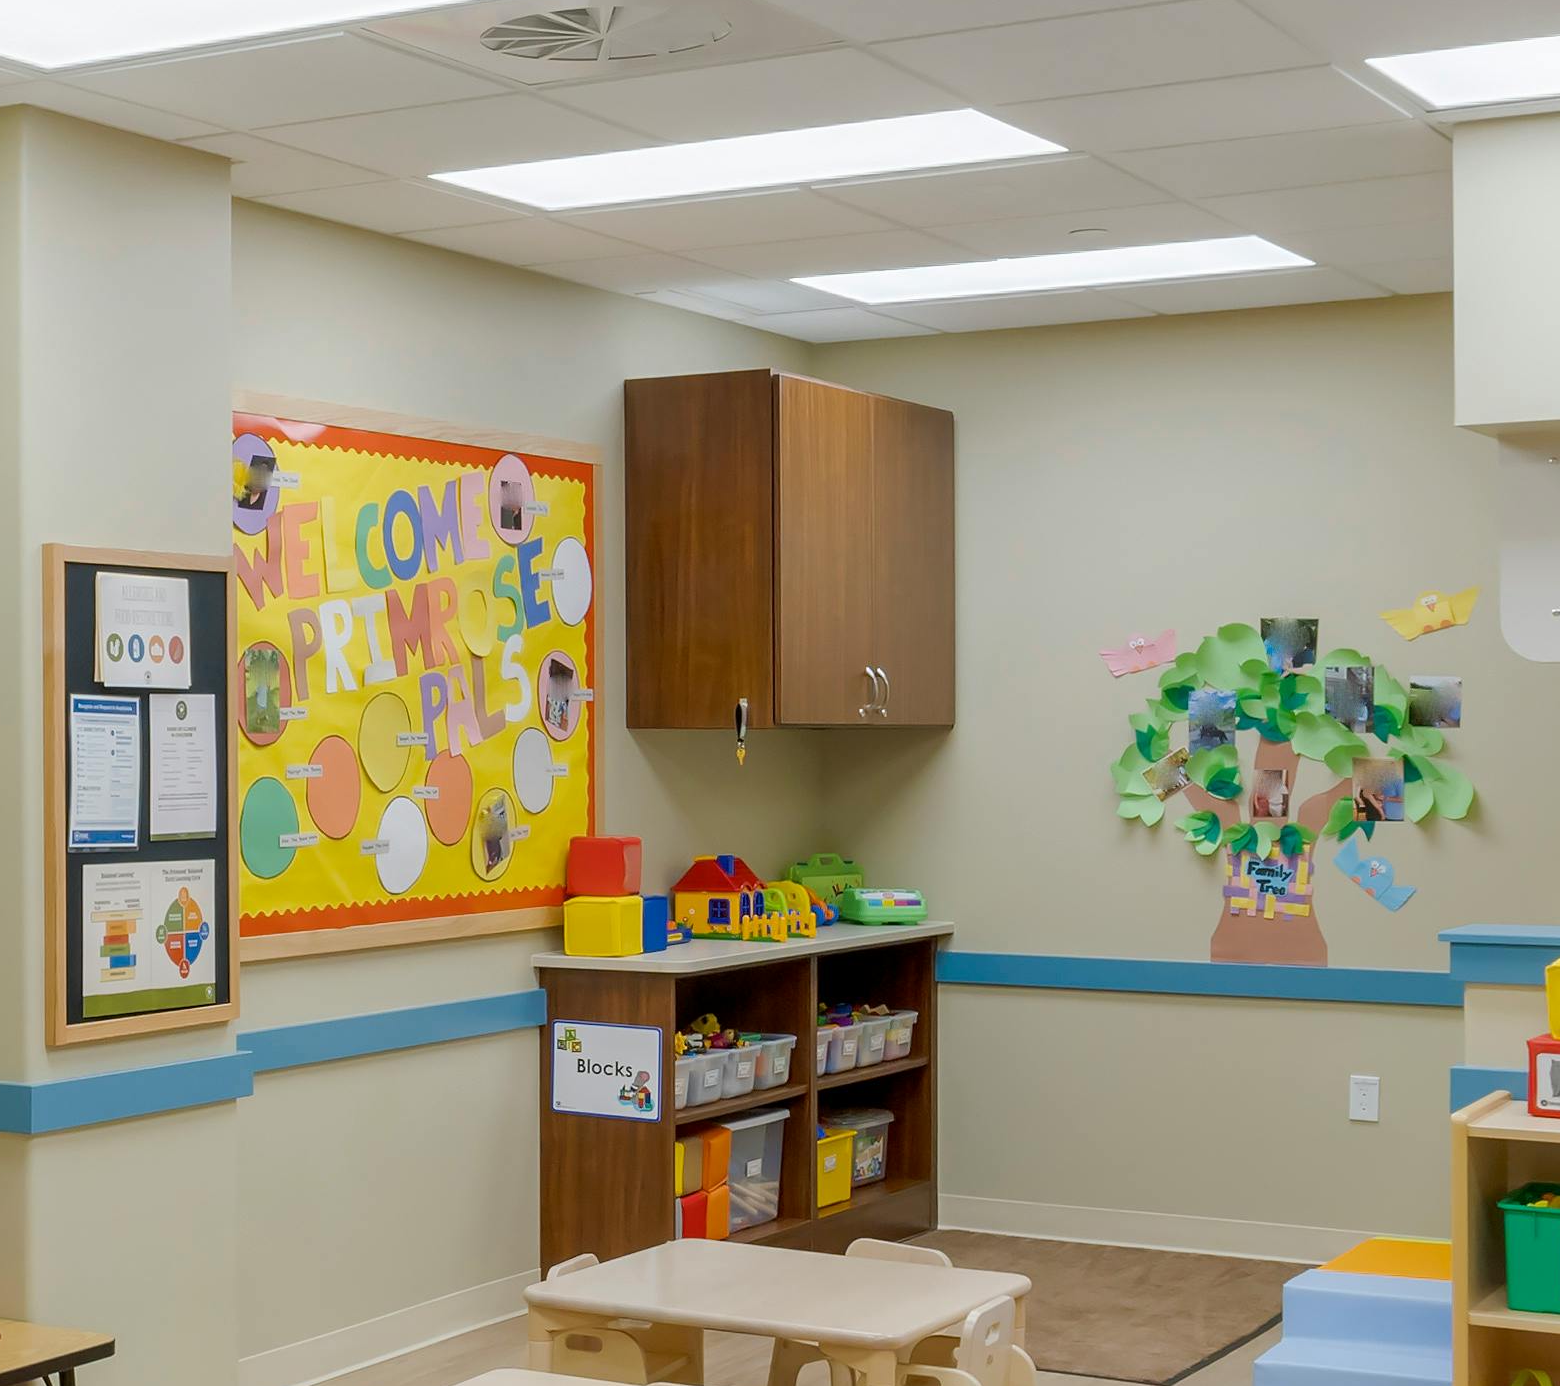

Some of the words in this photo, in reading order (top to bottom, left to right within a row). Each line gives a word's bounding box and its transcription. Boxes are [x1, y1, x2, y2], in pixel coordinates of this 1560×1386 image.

[233, 472, 490, 611] WELCOME
[287, 537, 551, 701] PRIMROSE
[419, 633, 532, 761] PALS
[1246, 861, 1292, 882] Family
[1256, 879, 1286, 896] Tree
[576, 1058, 633, 1078] Blocks
